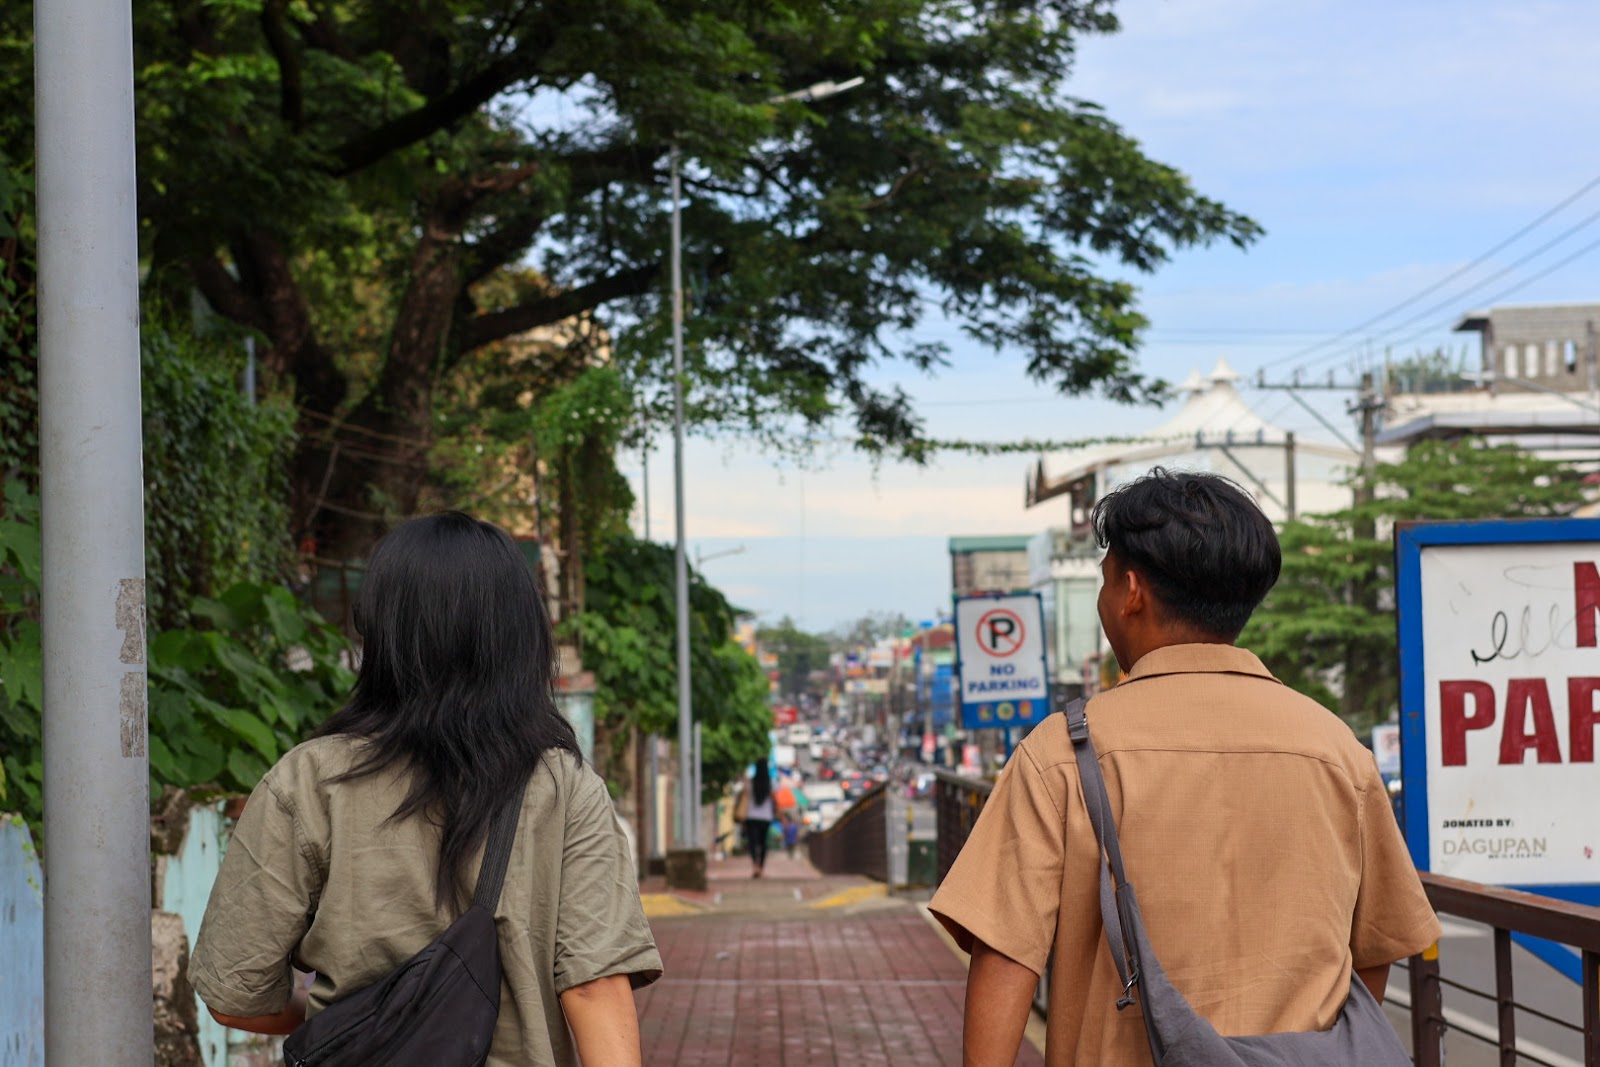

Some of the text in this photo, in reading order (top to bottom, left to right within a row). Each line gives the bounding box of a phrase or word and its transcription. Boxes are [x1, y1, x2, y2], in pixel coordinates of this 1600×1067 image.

[989, 617, 1015, 648] P
[990, 664, 1015, 675] NO
[968, 677, 1039, 692] PARKING
[1443, 818, 1493, 828] DONATED
[1442, 837, 1547, 855] DAGUPAN
